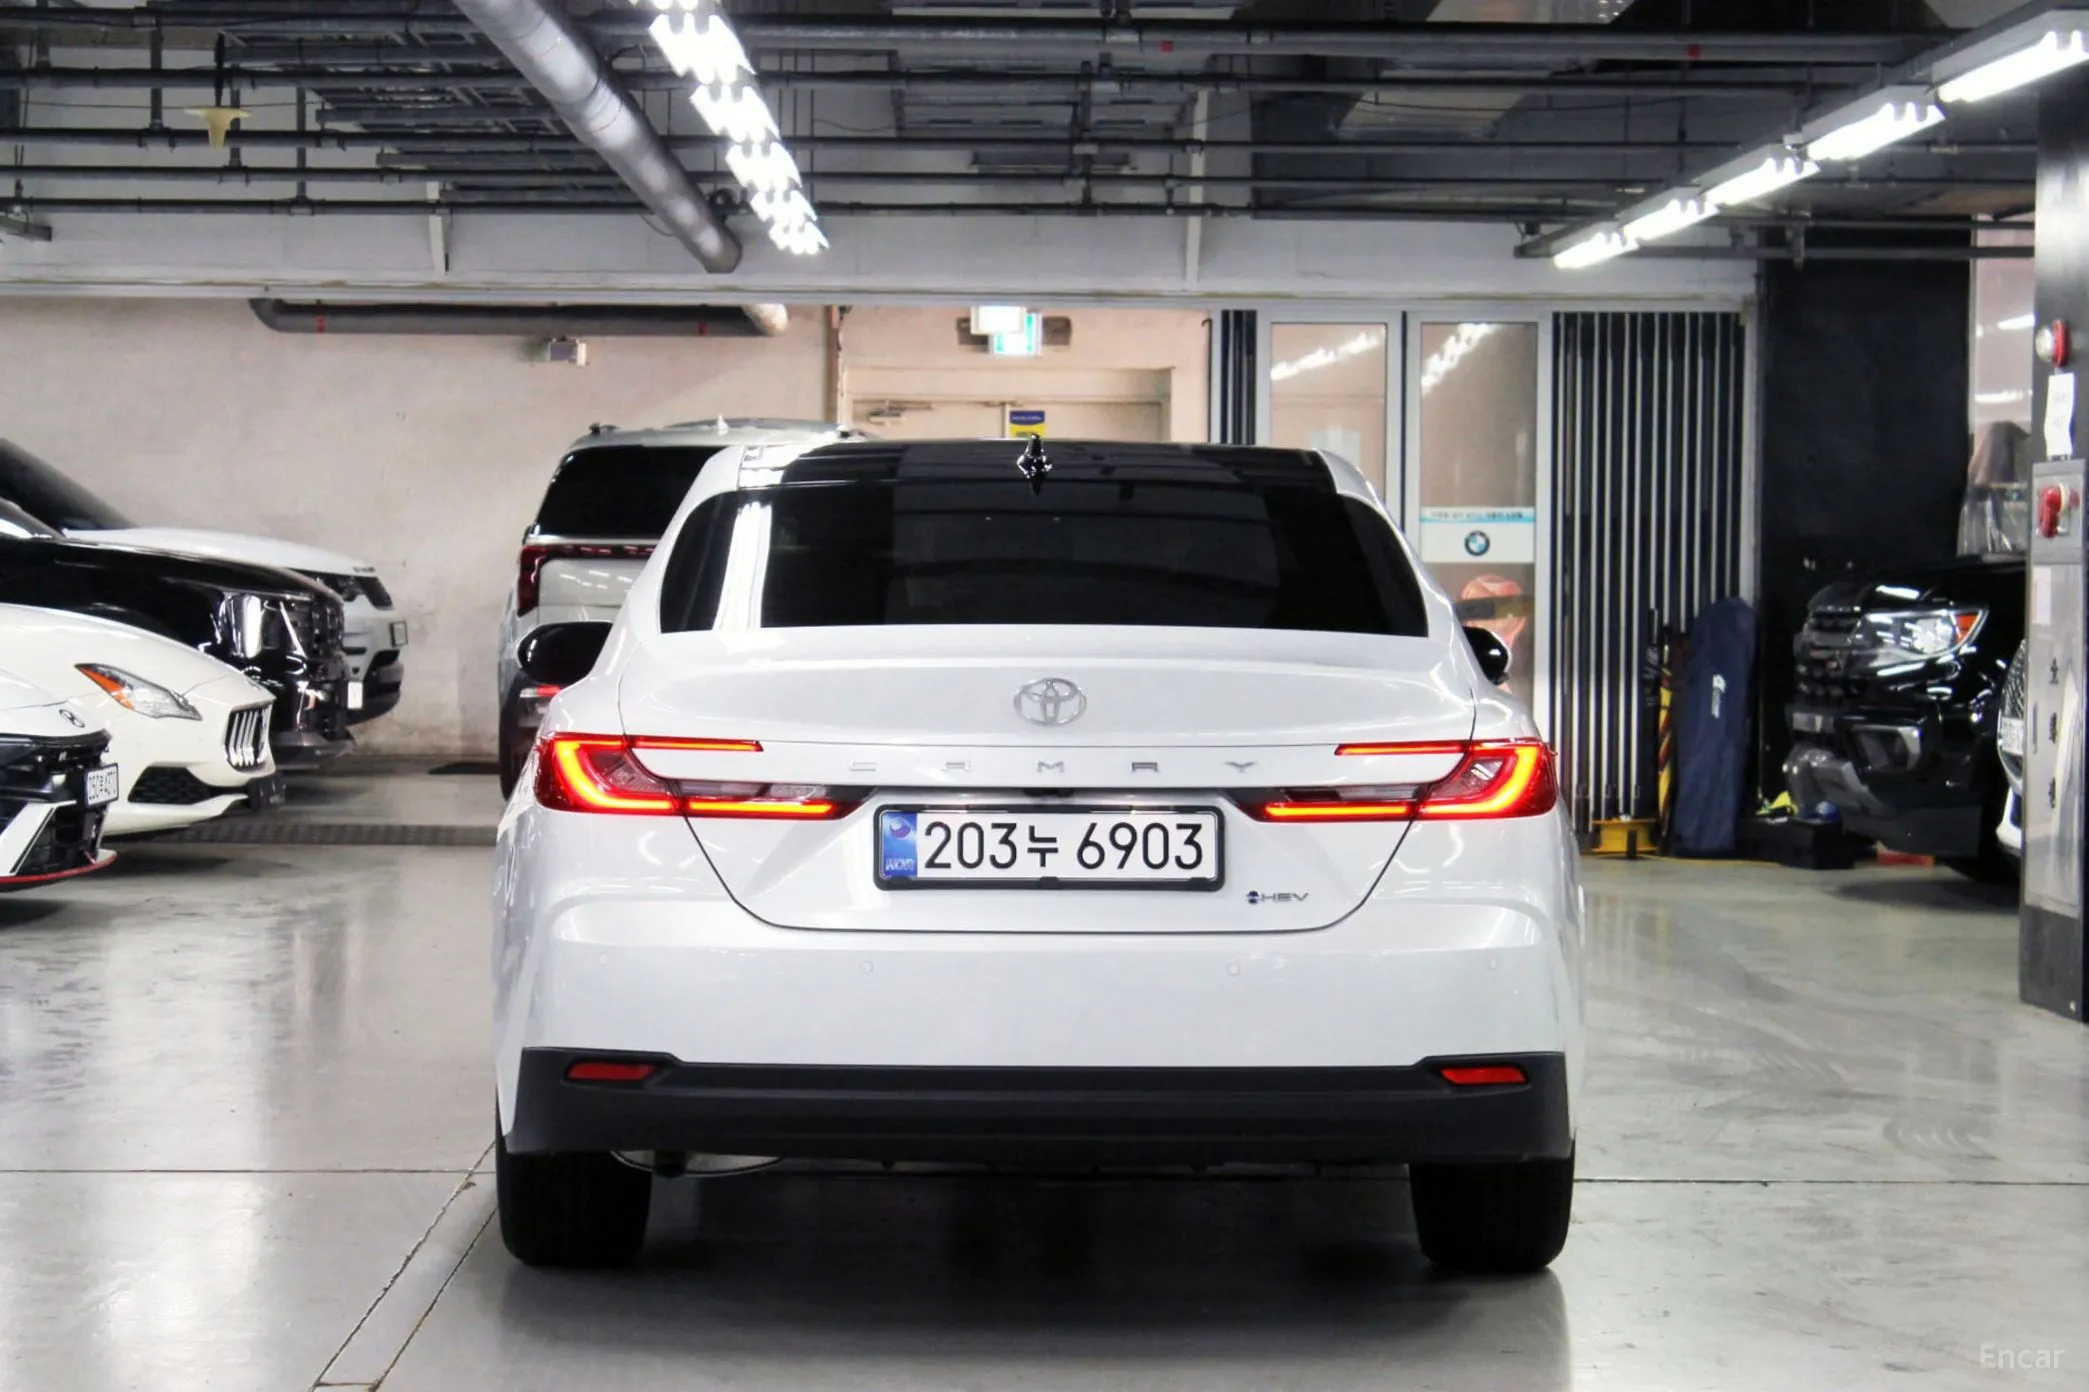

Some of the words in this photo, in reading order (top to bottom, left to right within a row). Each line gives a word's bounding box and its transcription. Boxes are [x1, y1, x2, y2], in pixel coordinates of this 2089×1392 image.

[849, 760, 1257, 773] CAMRY
[924, 821, 1059, 869] 203누
[1076, 821, 1203, 870] 6903
[1261, 892, 1309, 903] HEV
